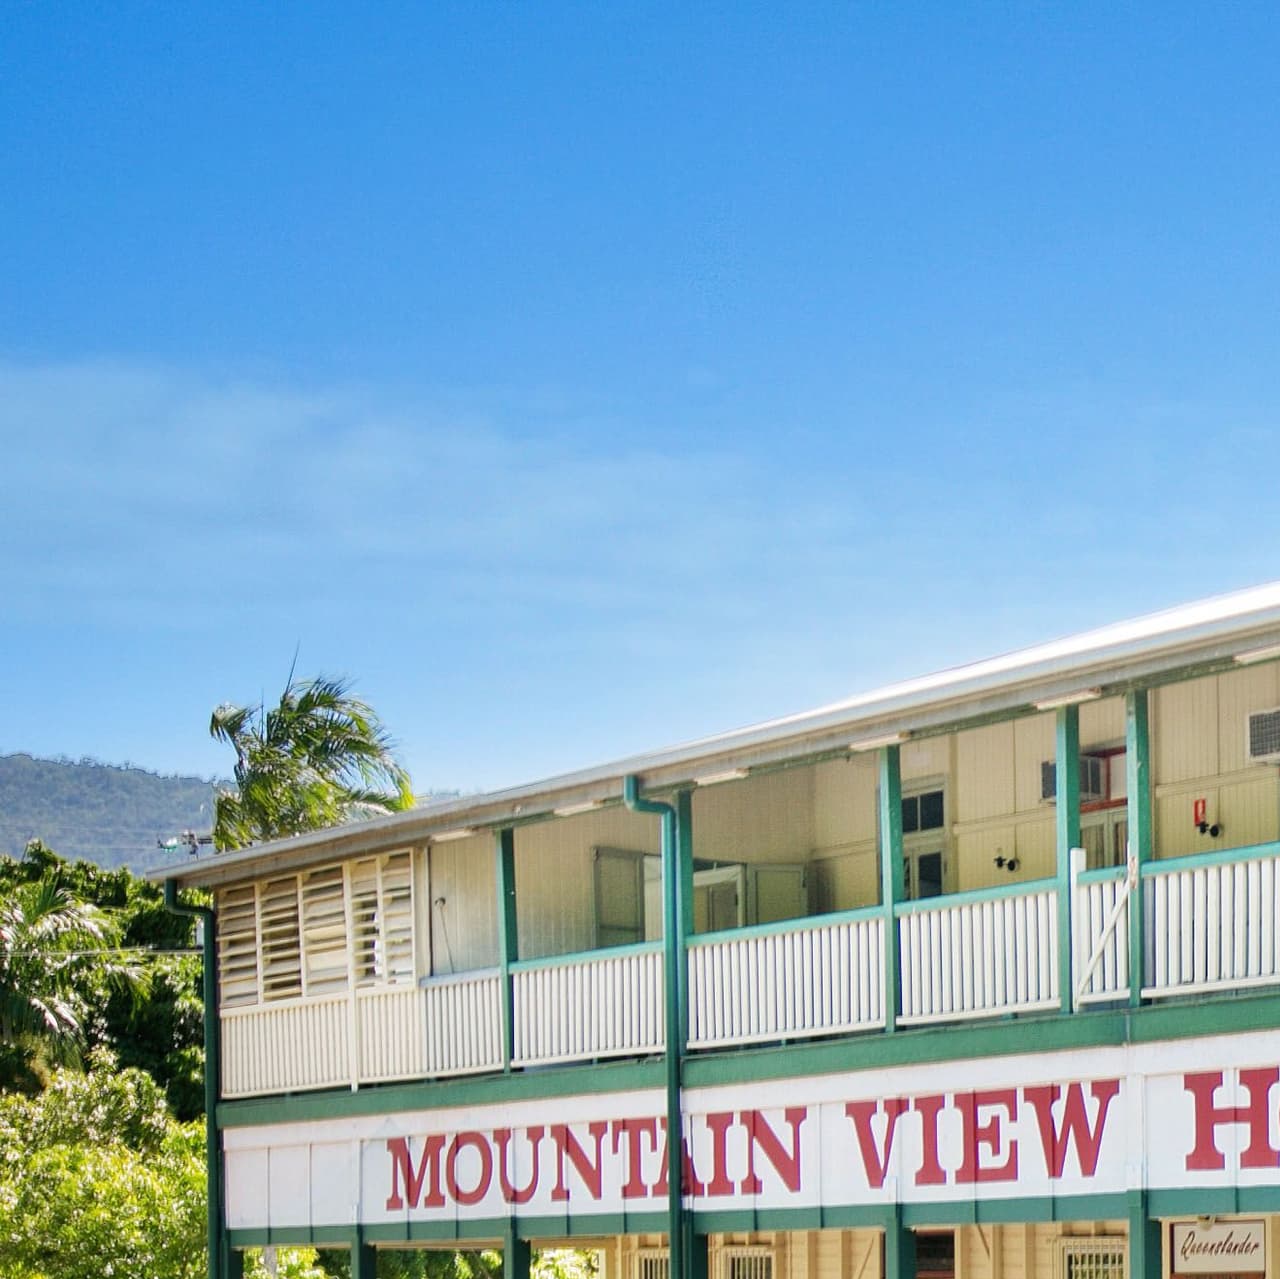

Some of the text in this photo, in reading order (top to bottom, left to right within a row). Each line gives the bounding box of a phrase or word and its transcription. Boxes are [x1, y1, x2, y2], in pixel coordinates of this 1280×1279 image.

[386, 1105, 807, 1211] MOUNTAIN
[845, 1079, 1120, 1189] VIEW
[1181, 1230, 1260, 1261] Queenslander
